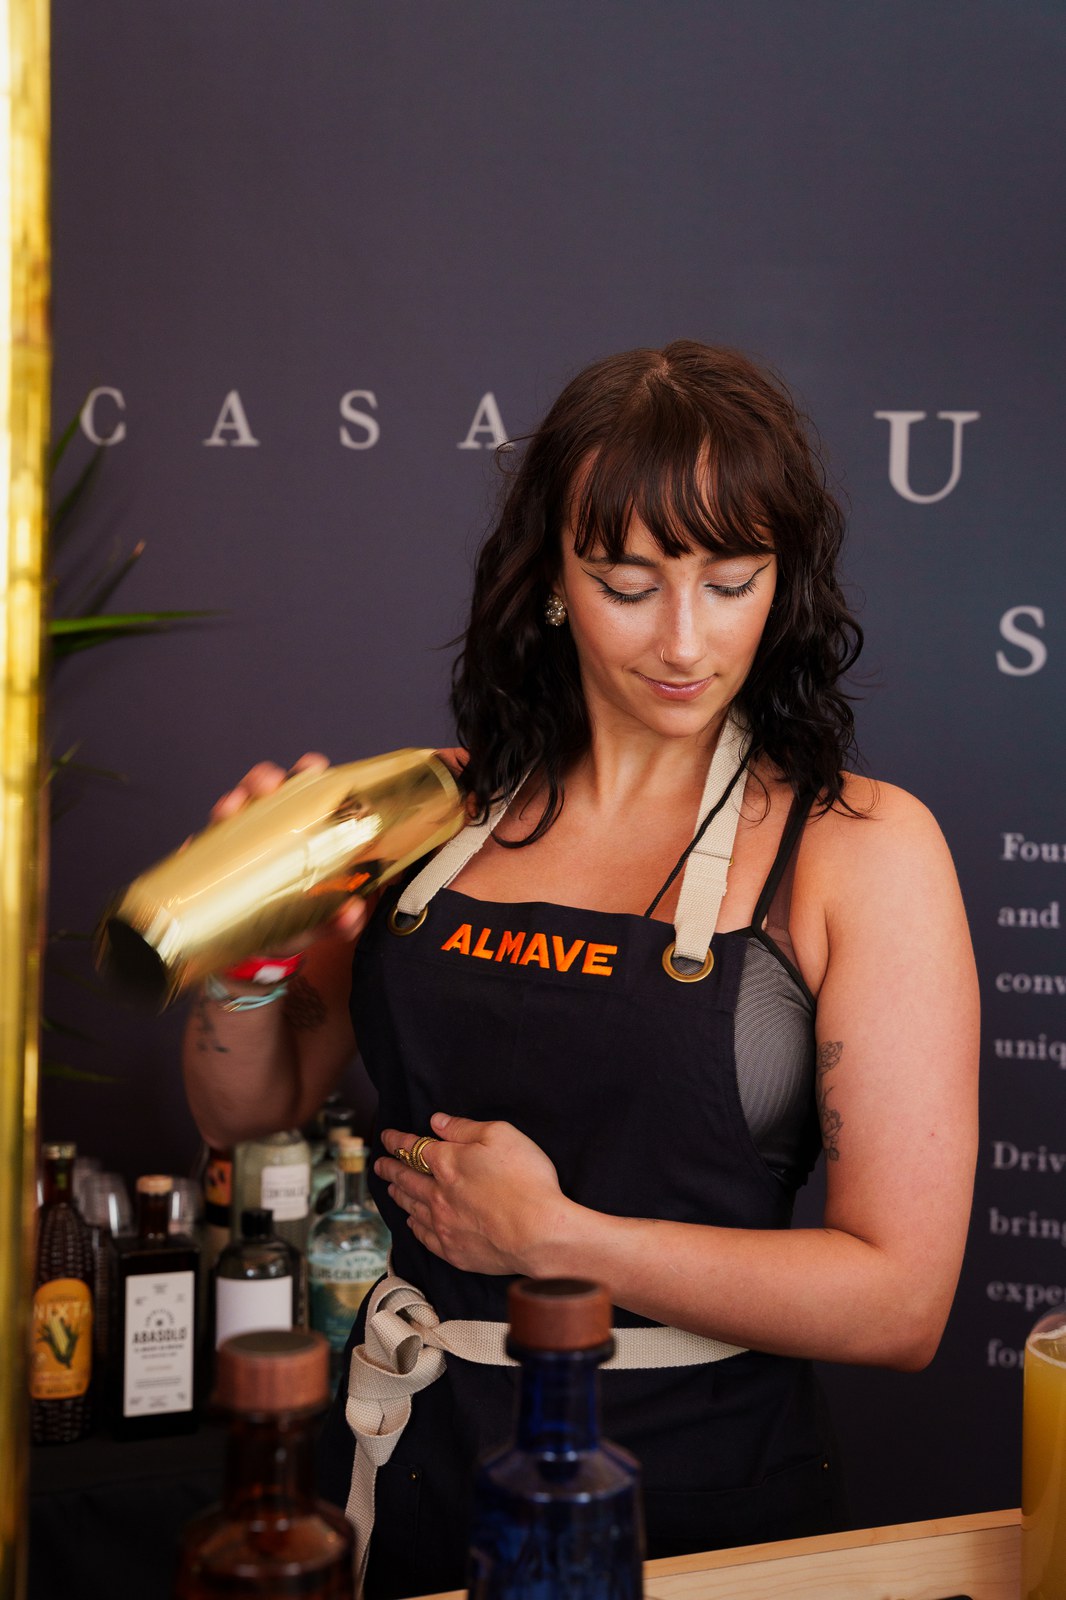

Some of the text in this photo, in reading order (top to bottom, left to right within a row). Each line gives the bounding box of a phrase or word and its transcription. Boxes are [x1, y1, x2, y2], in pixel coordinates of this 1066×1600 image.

[80, 386, 515, 450] CASA
[1001, 832, 1066, 863] Fou
[997, 901, 1060, 929] and
[440, 923, 618, 977] ALMAVE
[986, 1280, 1066, 1311] expe
[132, 1326, 188, 1344] ABASOLO
